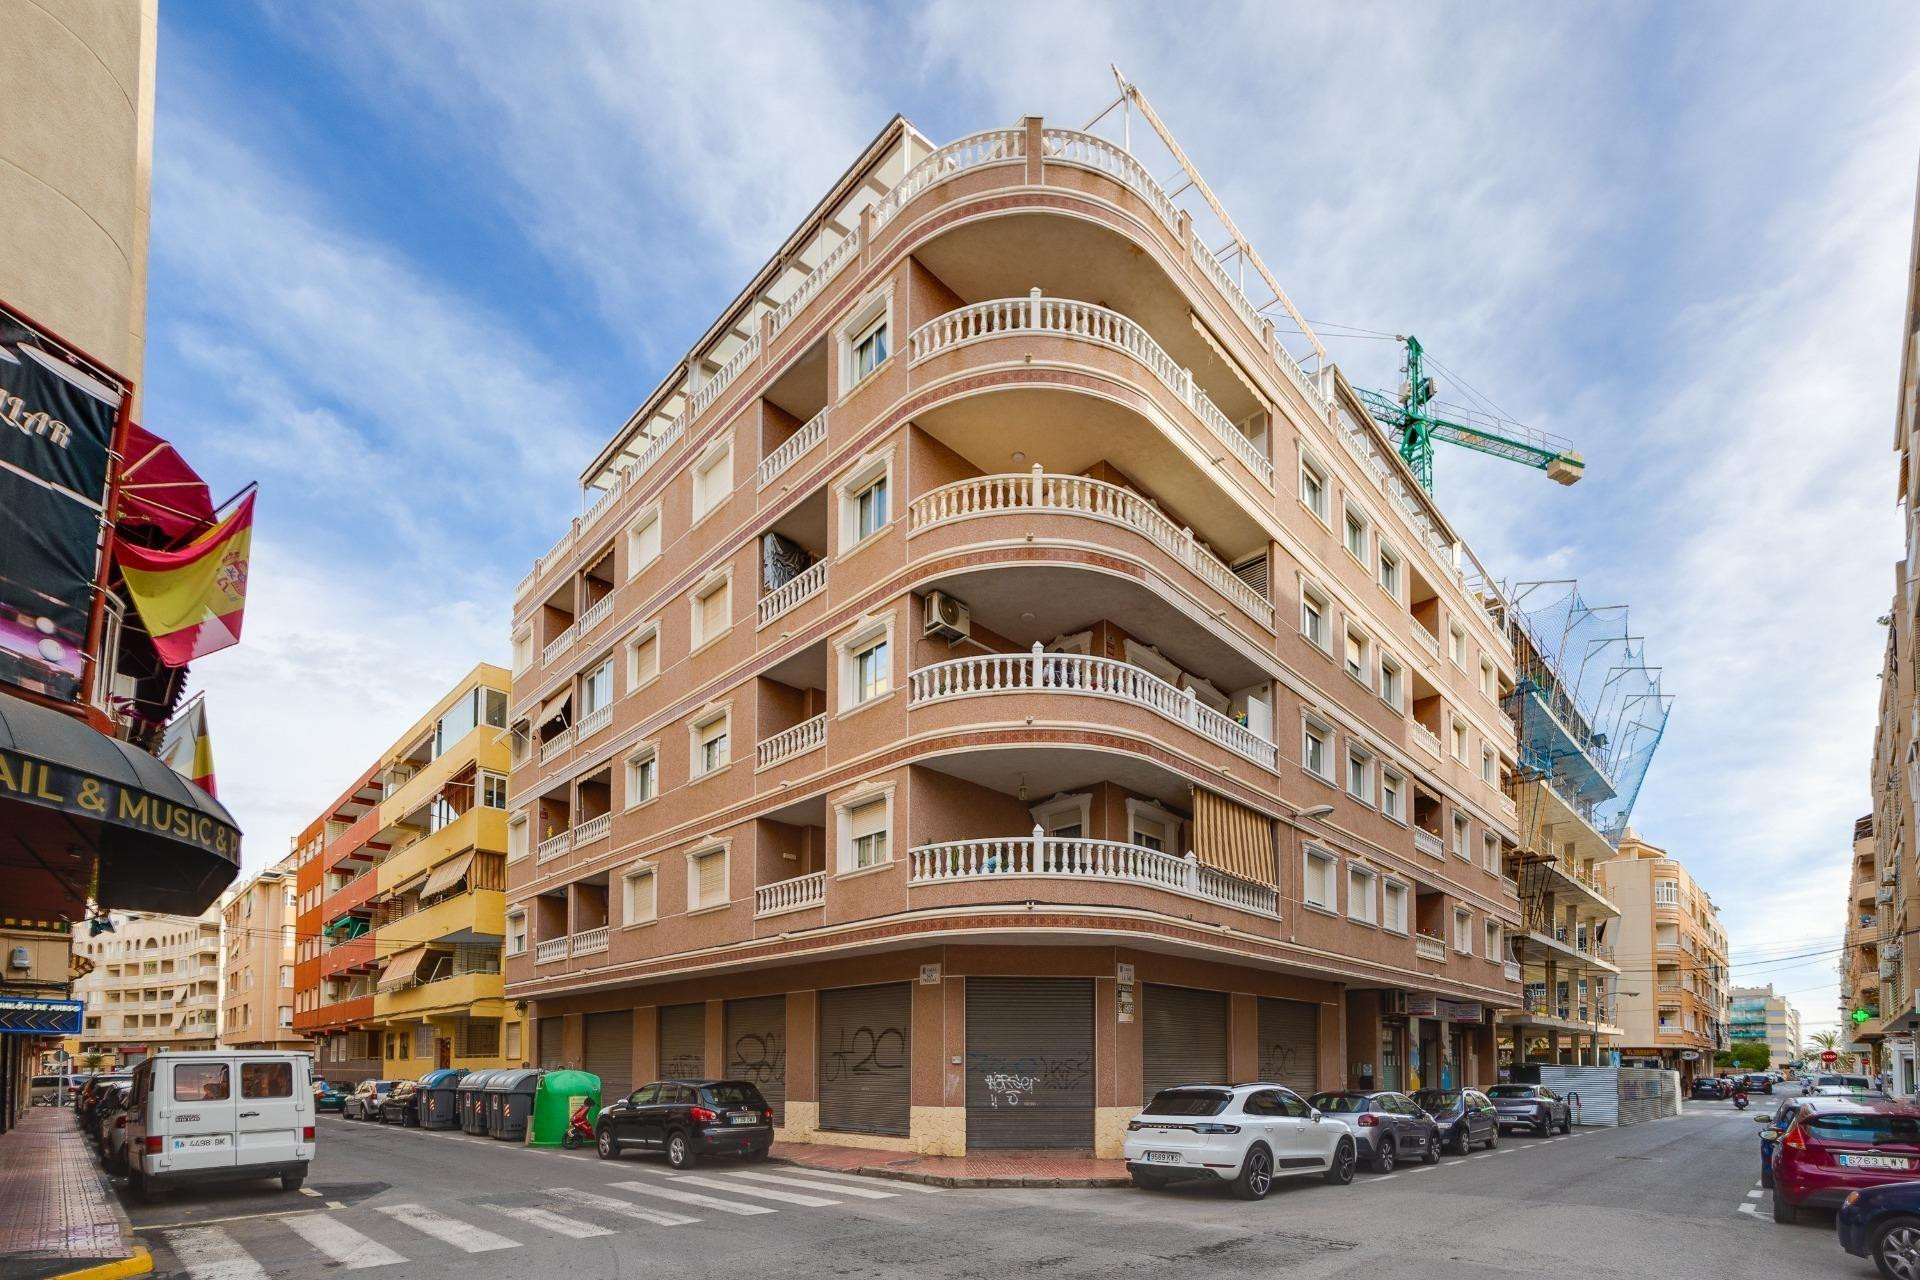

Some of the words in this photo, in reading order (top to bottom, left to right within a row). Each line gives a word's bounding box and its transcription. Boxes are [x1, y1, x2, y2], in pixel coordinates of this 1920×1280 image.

[77, 778, 105, 812] &
[118, 788, 212, 845] MUSIC
[216, 826, 226, 853] &
[33, 1003, 48, 1011] DE
